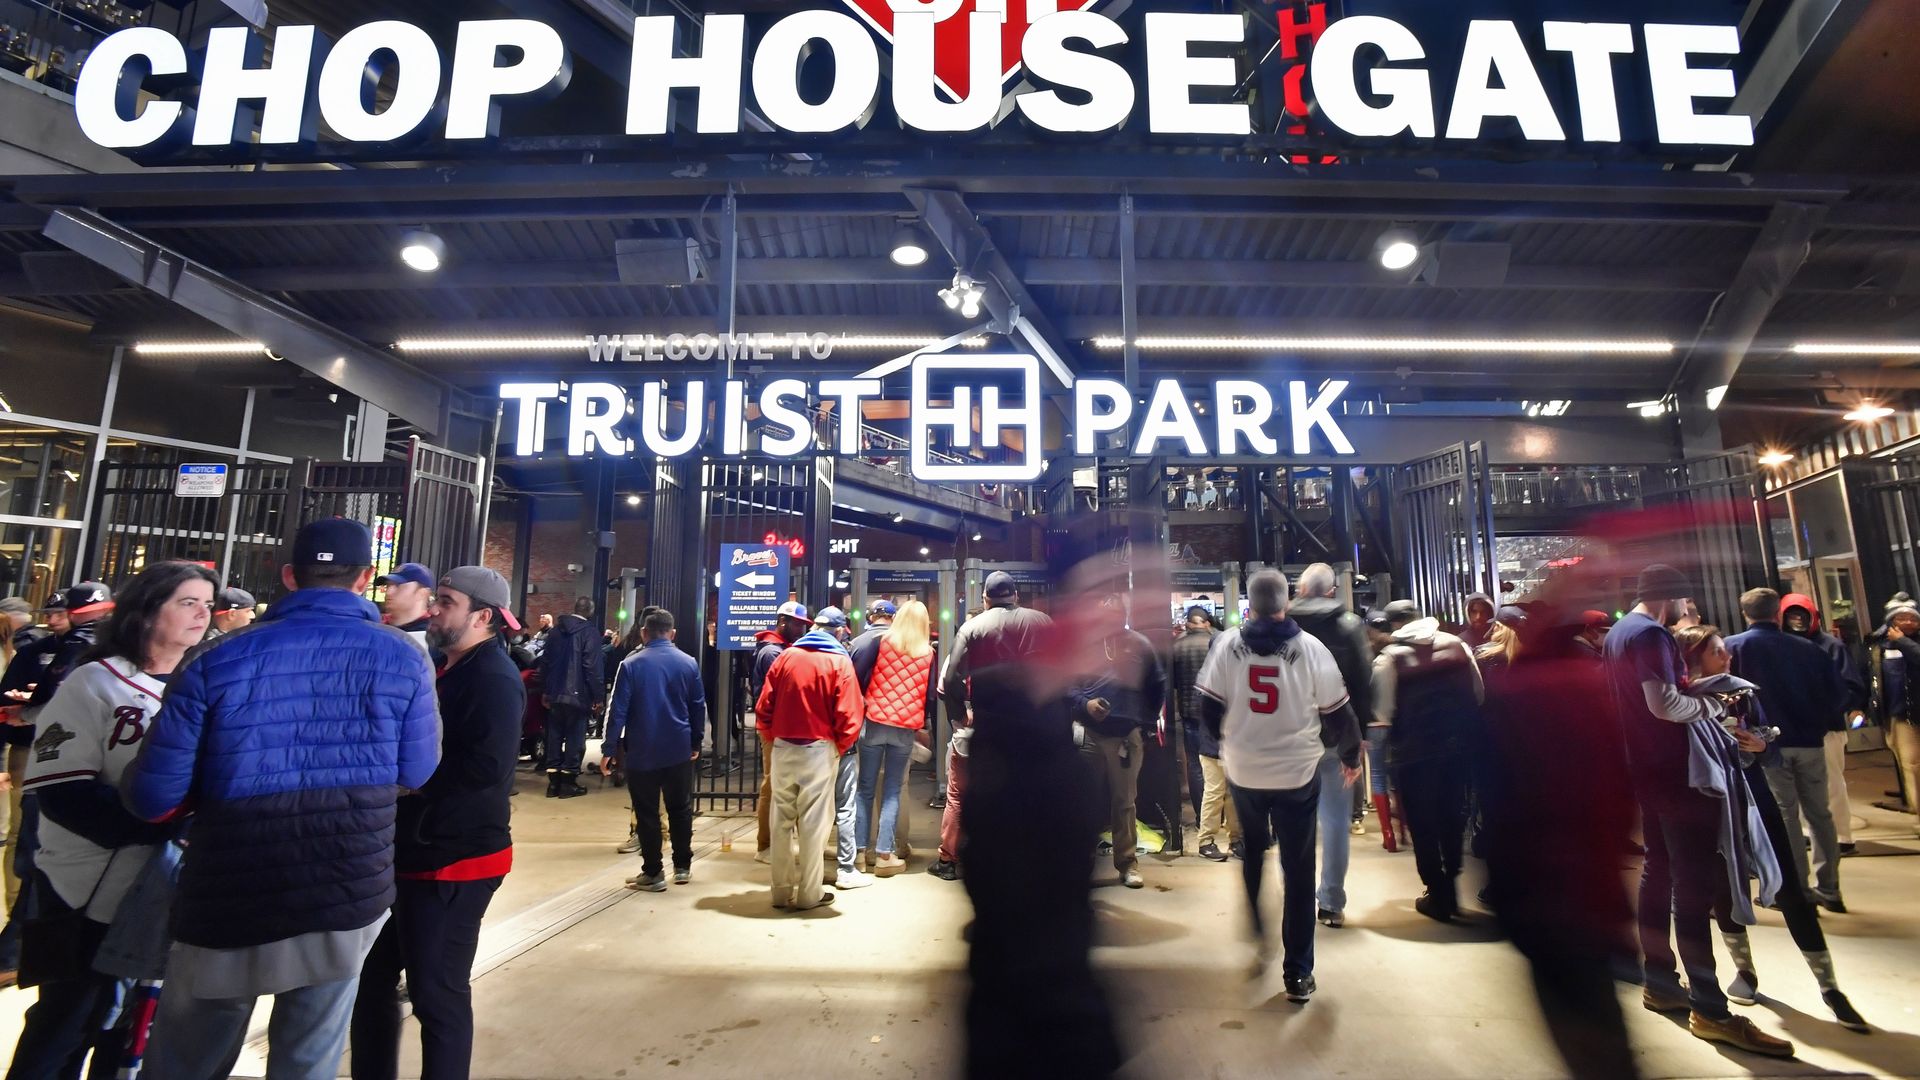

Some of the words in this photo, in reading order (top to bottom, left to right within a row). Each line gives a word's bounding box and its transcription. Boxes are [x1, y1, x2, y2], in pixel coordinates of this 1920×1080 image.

[76, 20, 564, 149] CHOP
[626, 10, 1250, 135] HOUSE
[1312, 16, 1754, 146] GATE
[585, 333, 773, 362] WELCOME
[786, 332, 833, 361] TO
[500, 379, 881, 456] TRUIST
[1076, 379, 1355, 455] PARK
[1248, 664, 1280, 715] 5
